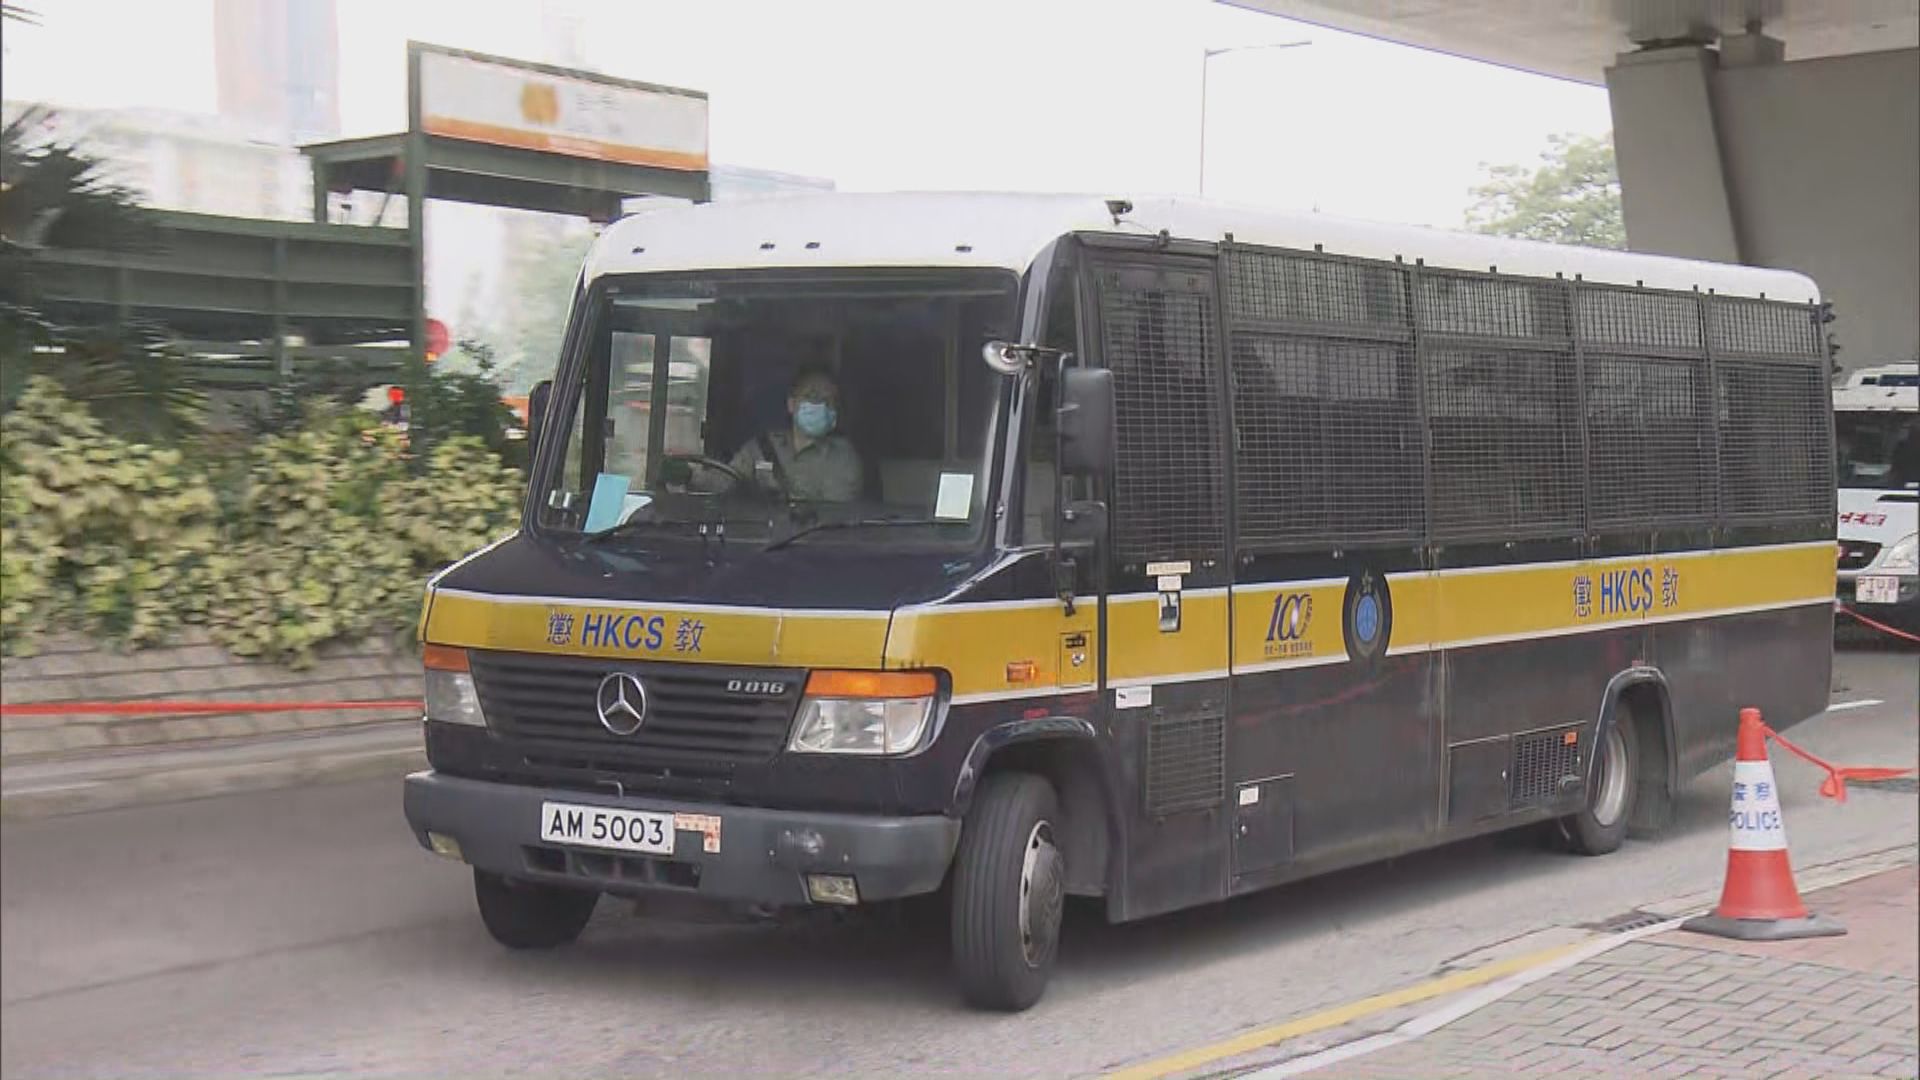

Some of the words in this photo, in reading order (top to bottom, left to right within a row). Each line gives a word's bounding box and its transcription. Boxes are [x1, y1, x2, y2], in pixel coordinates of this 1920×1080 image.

[1601, 568, 1653, 614] HKCS
[581, 614, 664, 650] HKCS
[1265, 593, 1312, 641] 100
[549, 809, 583, 837] AM
[591, 814, 664, 846] 5003
[1729, 810, 1780, 830] POLICE
